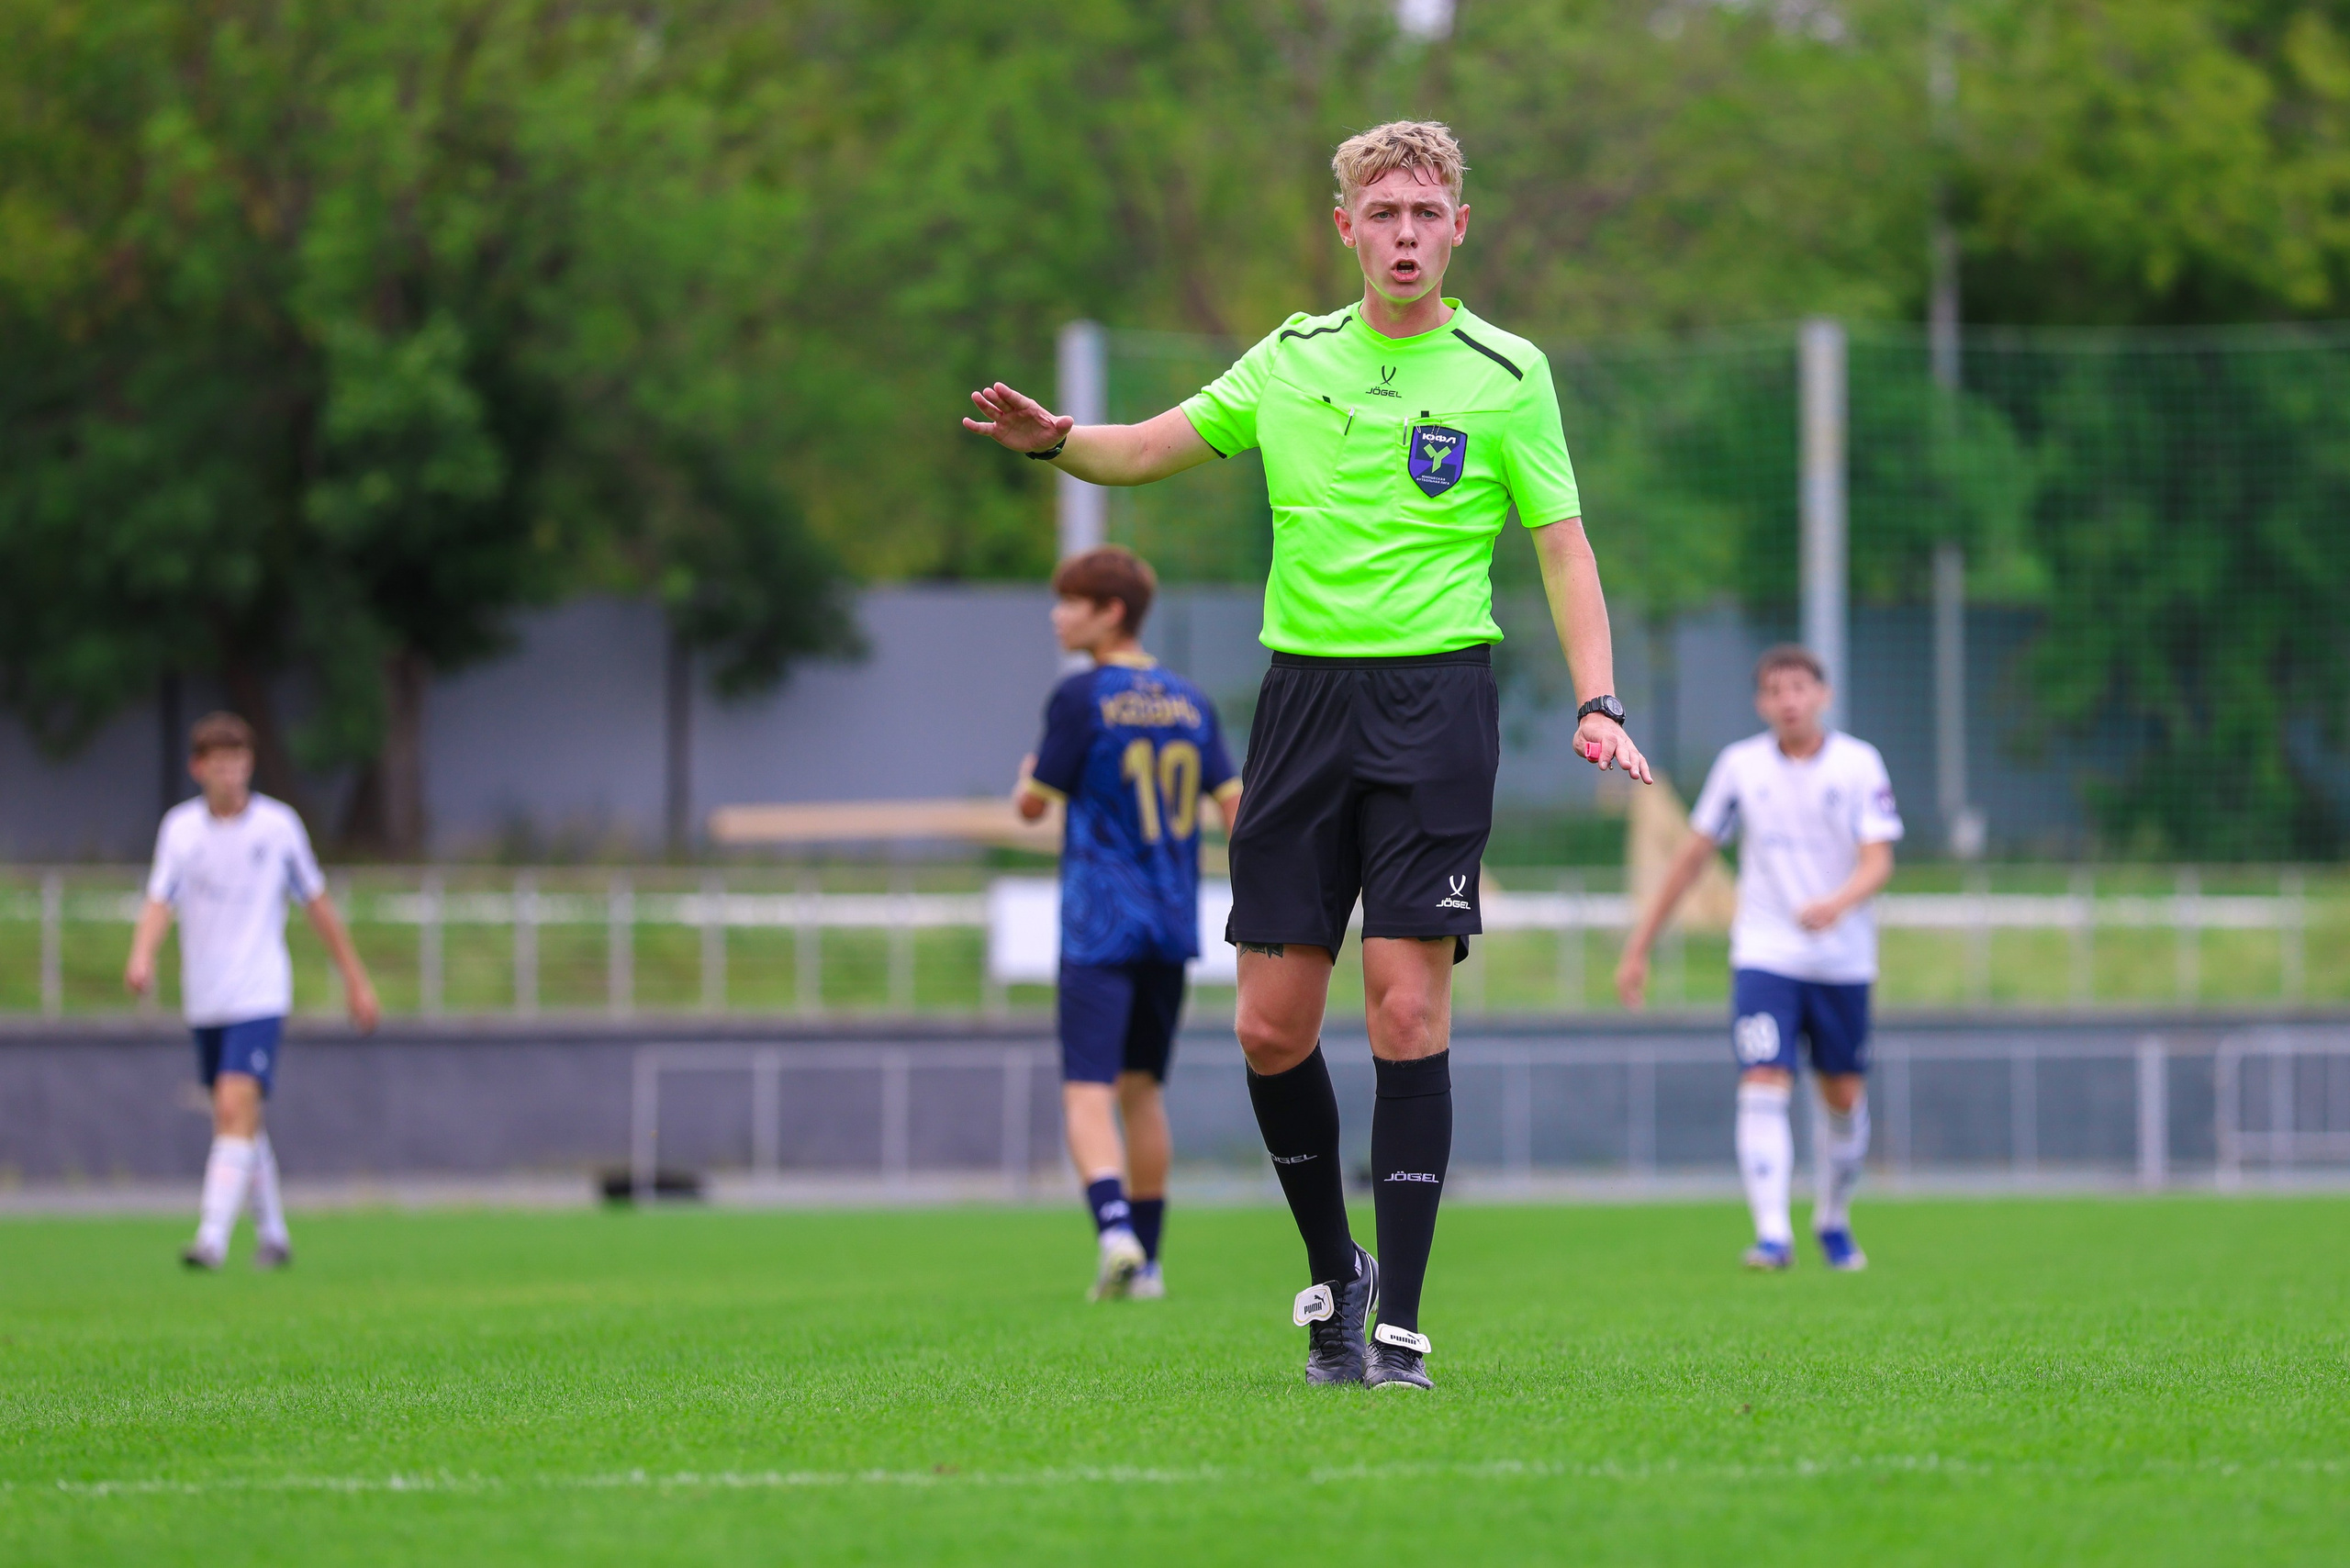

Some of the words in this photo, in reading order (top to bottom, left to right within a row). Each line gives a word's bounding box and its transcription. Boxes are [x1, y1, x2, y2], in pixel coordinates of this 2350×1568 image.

[1365, 386, 1402, 398] JÖGEL
[1422, 432, 1457, 444] ЮФЛ
[1122, 737, 1202, 845] 10
[1435, 897, 1472, 910] JÖGEL
[1383, 1170, 1439, 1183] JÖGEL
[1304, 1301, 1323, 1315] PUMA
